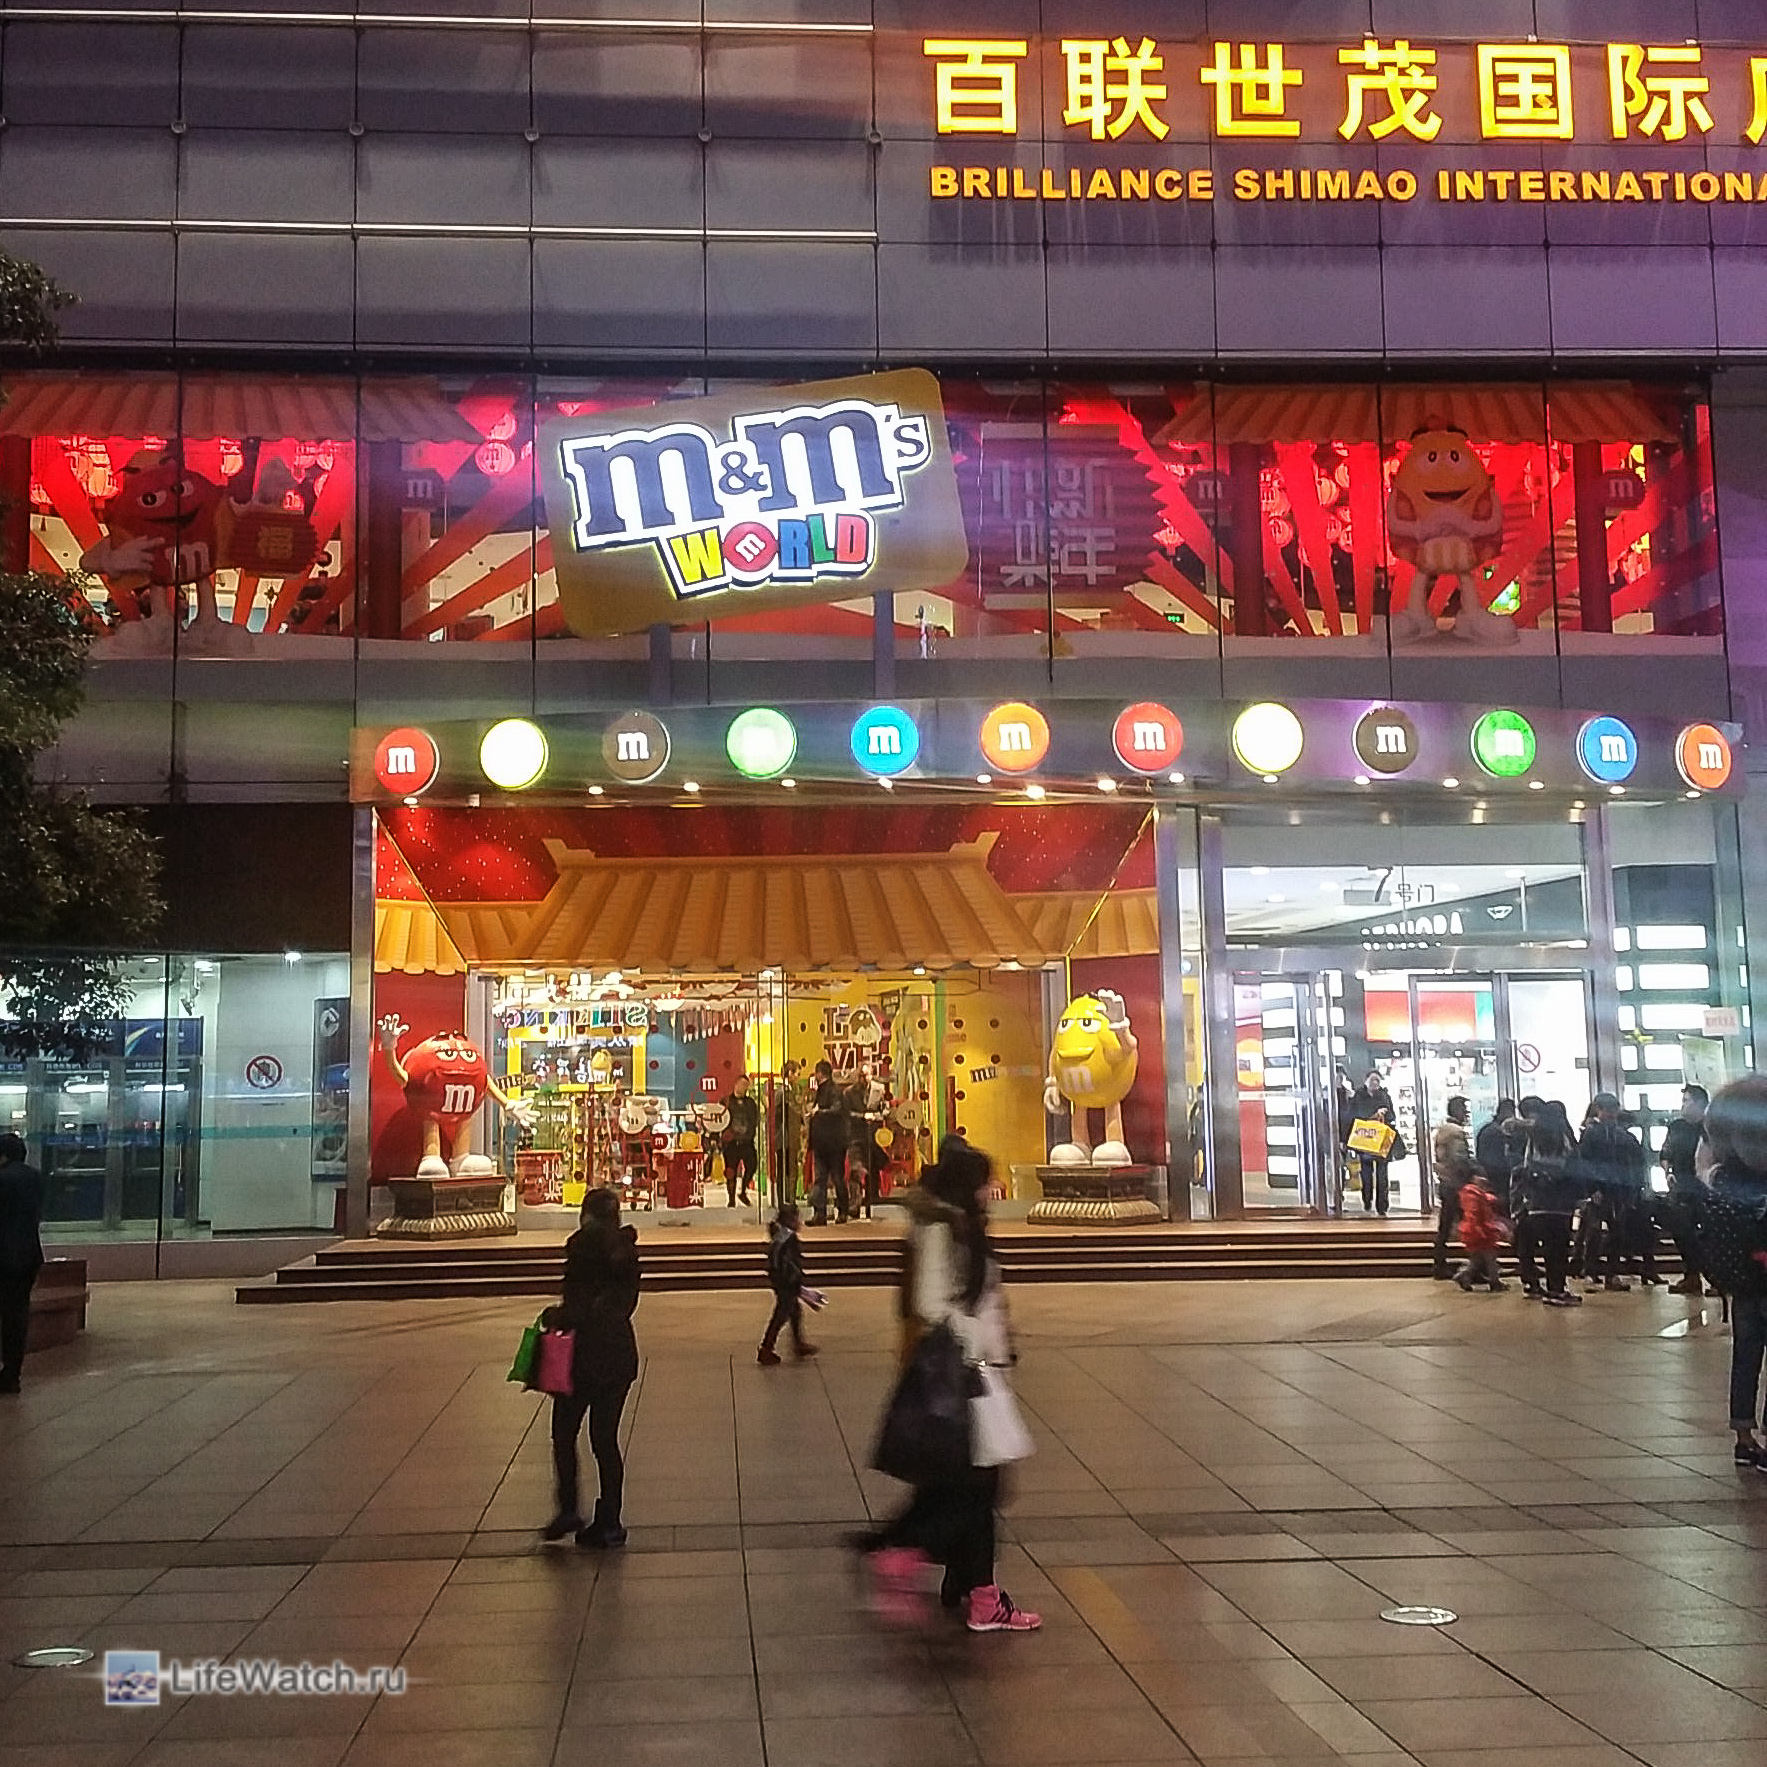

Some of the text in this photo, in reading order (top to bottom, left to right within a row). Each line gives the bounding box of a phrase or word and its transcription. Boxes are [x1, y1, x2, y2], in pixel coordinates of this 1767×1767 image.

[923, 36, 1767, 144] 百联世茂国际
[931, 166, 1214, 200] BRILLIANCE
[1234, 168, 1417, 201] SHIMAO
[669, 513, 870, 584] WORLD
[617, 731, 650, 761] m
[867, 724, 901, 754] m
[998, 722, 1032, 751] m
[1133, 721, 1166, 751] m
[1375, 725, 1407, 754] m
[1494, 729, 1525, 756] m
[1600, 734, 1628, 762] m
[387, 746, 416, 774] m
[1698, 742, 1723, 769] m
[701, 1077, 717, 1091] m
[1062, 1066, 1095, 1093] m
[441, 1084, 475, 1113] m
